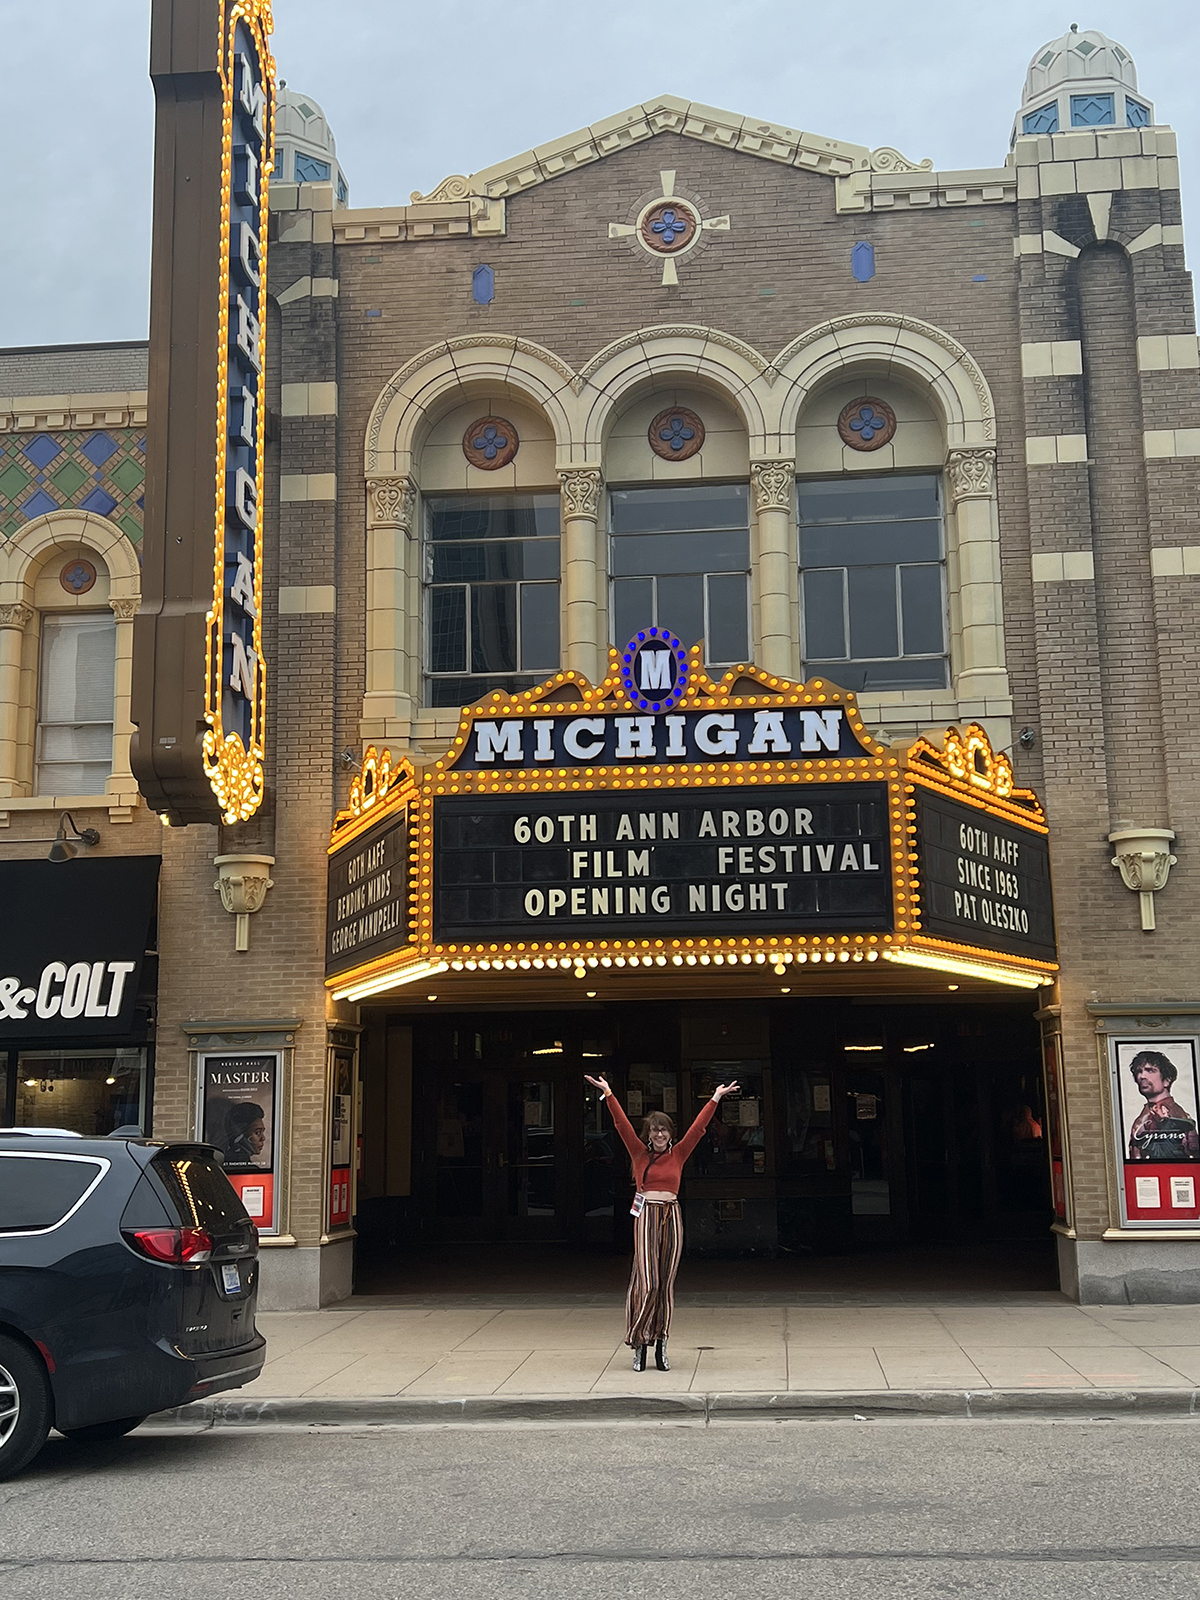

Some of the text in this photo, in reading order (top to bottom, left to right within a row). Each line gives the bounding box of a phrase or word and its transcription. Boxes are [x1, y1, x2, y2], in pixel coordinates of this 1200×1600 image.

[229, 52, 267, 701] MICHIGAN
[639, 649, 672, 690] M
[474, 710, 843, 762] MICHIGAN
[514, 808, 814, 844] 60TH ANN ARBOR
[960, 823, 1019, 863] 60TH AAFF
[348, 839, 386, 885] 60TH AAFF
[718, 843, 879, 874] FESTIVAL
[957, 856, 1020, 900] SINCE 1963
[337, 870, 391, 922] BENDING MINDS
[524, 883, 788, 917] OPENING NIGHT
[953, 890, 1029, 934] PAT OLESZKO
[331, 899, 401, 955] GEORGE MANUPELLI
[210, 1071, 270, 1084] MASTER
[1134, 1120, 1186, 1149] Cyrano
